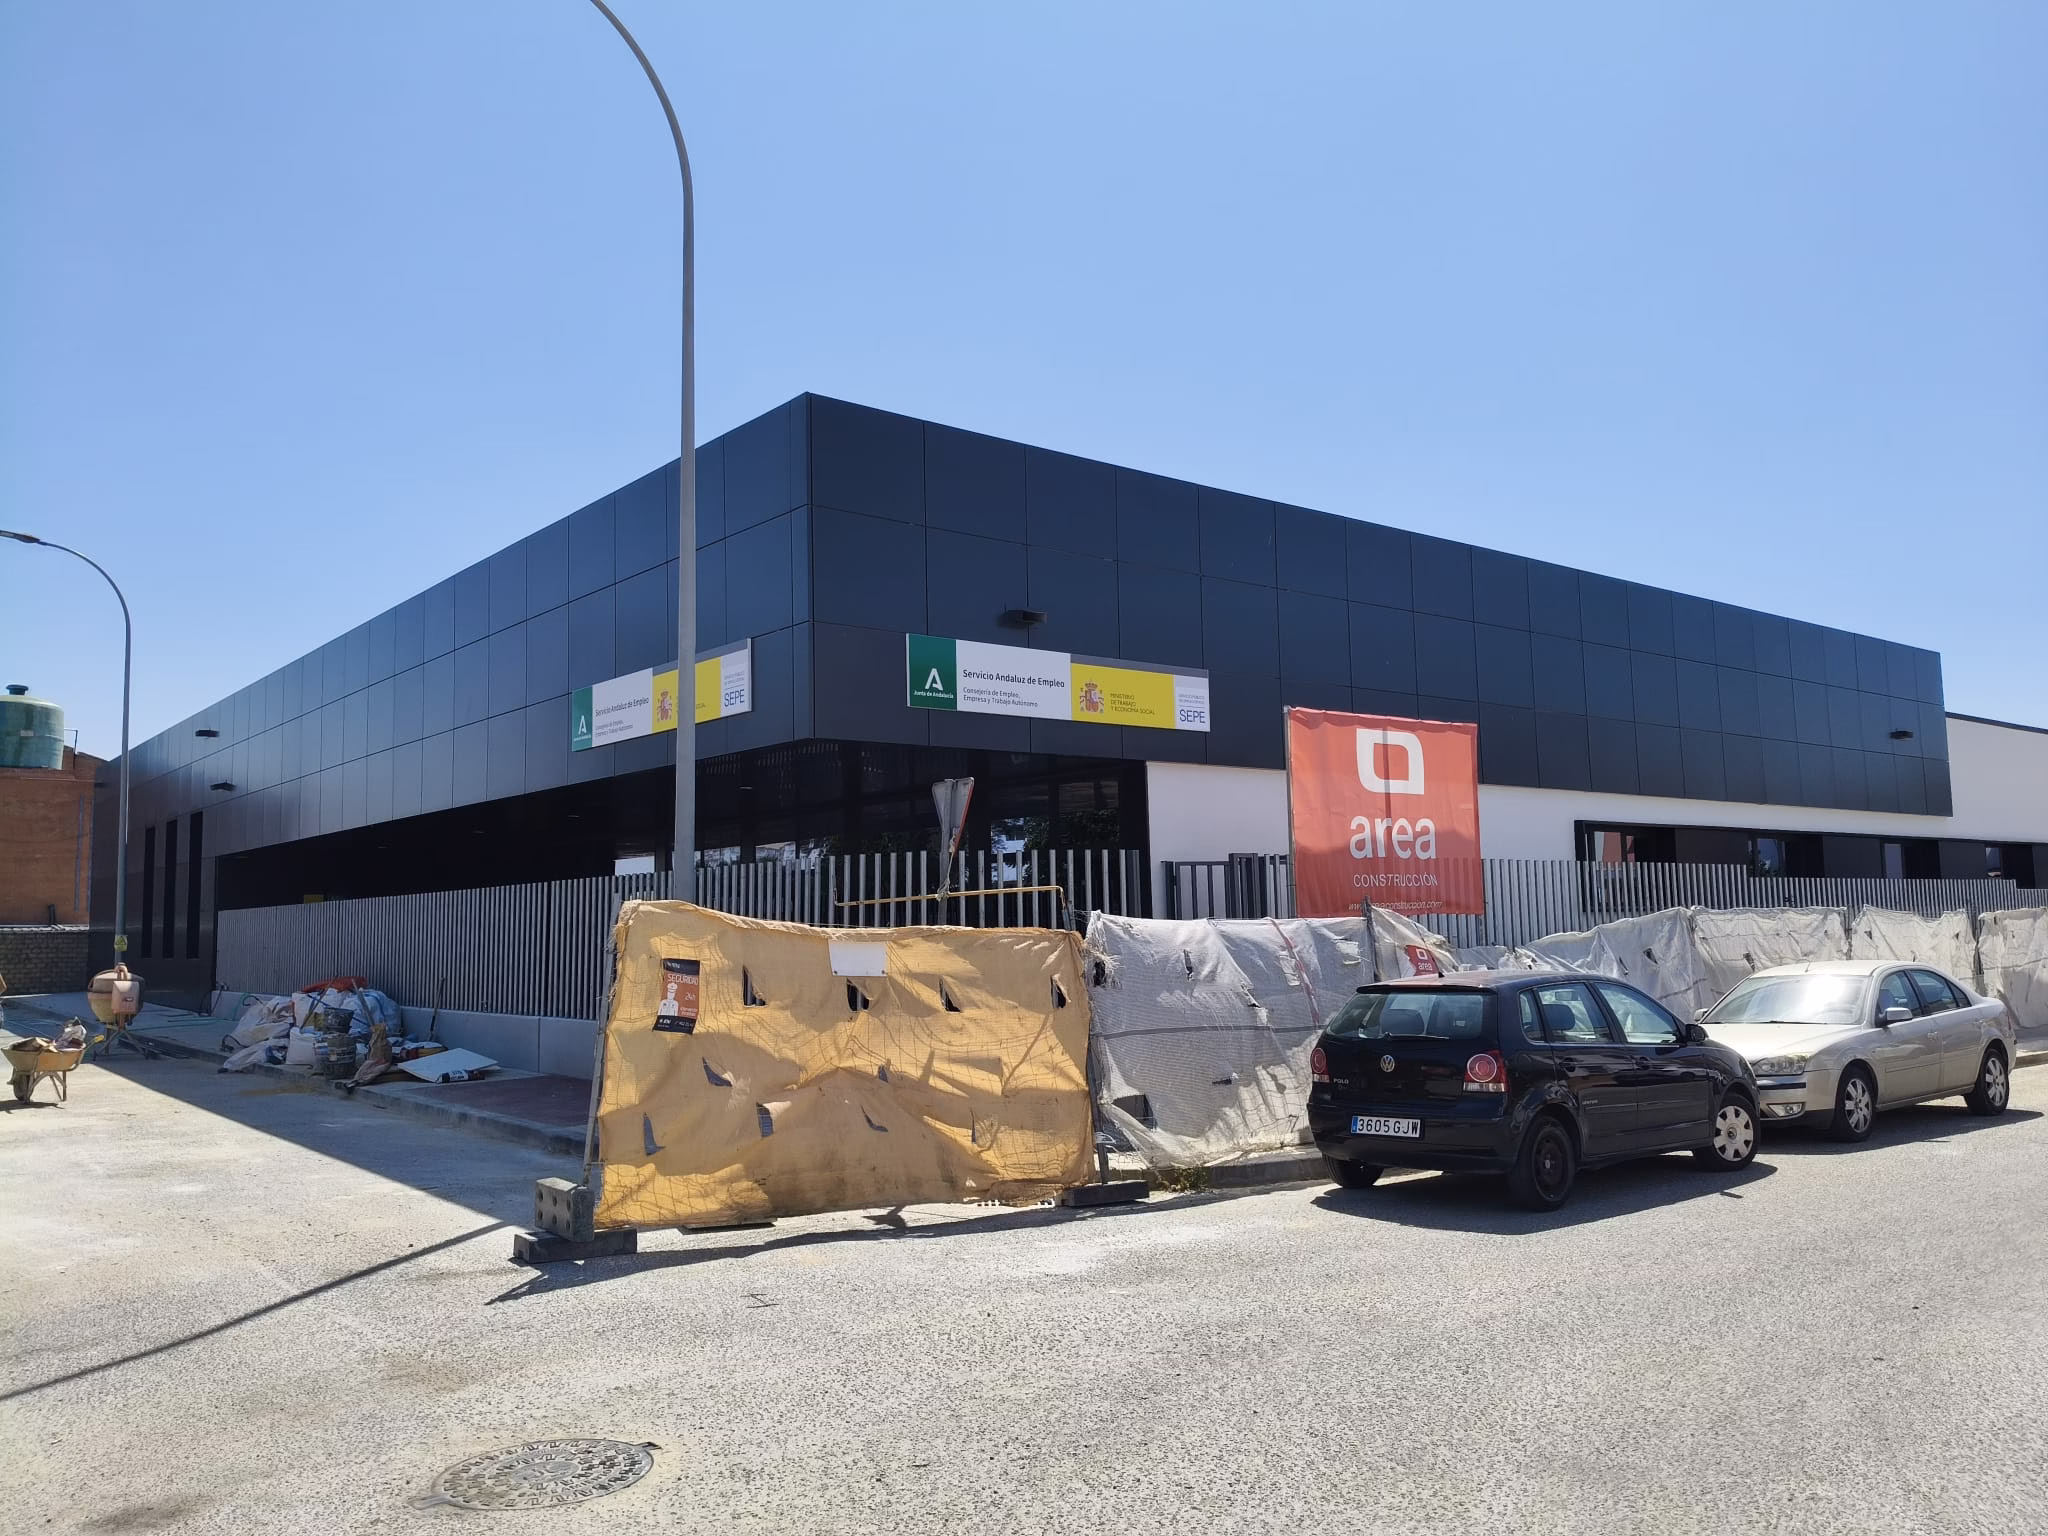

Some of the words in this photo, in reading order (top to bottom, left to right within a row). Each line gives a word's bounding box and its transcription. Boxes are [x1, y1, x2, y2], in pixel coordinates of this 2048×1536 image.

[963, 669, 994, 681] Servicio
[996, 674, 1025, 684] Andaluz
[1027, 676, 1037, 685] de
[1038, 678, 1065, 688] Empleo
[723, 688, 745, 707] SEPE
[933, 691, 954, 699] Andalucía
[963, 686, 991, 697] Consejería
[633, 697, 649, 707] Empleo
[963, 695, 987, 703] Empresa
[992, 697, 1011, 706] Trabajo
[1012, 699, 1038, 708] Autónomo
[1179, 709, 1206, 724] SEPE
[1350, 815, 1437, 860] area
[1353, 871, 1438, 888] CONSTRUCCIÓN
[667, 973, 698, 985] SEGURIDAD
[1358, 1118, 1390, 1133] 3605
[1393, 1120, 1419, 1136] GJW
